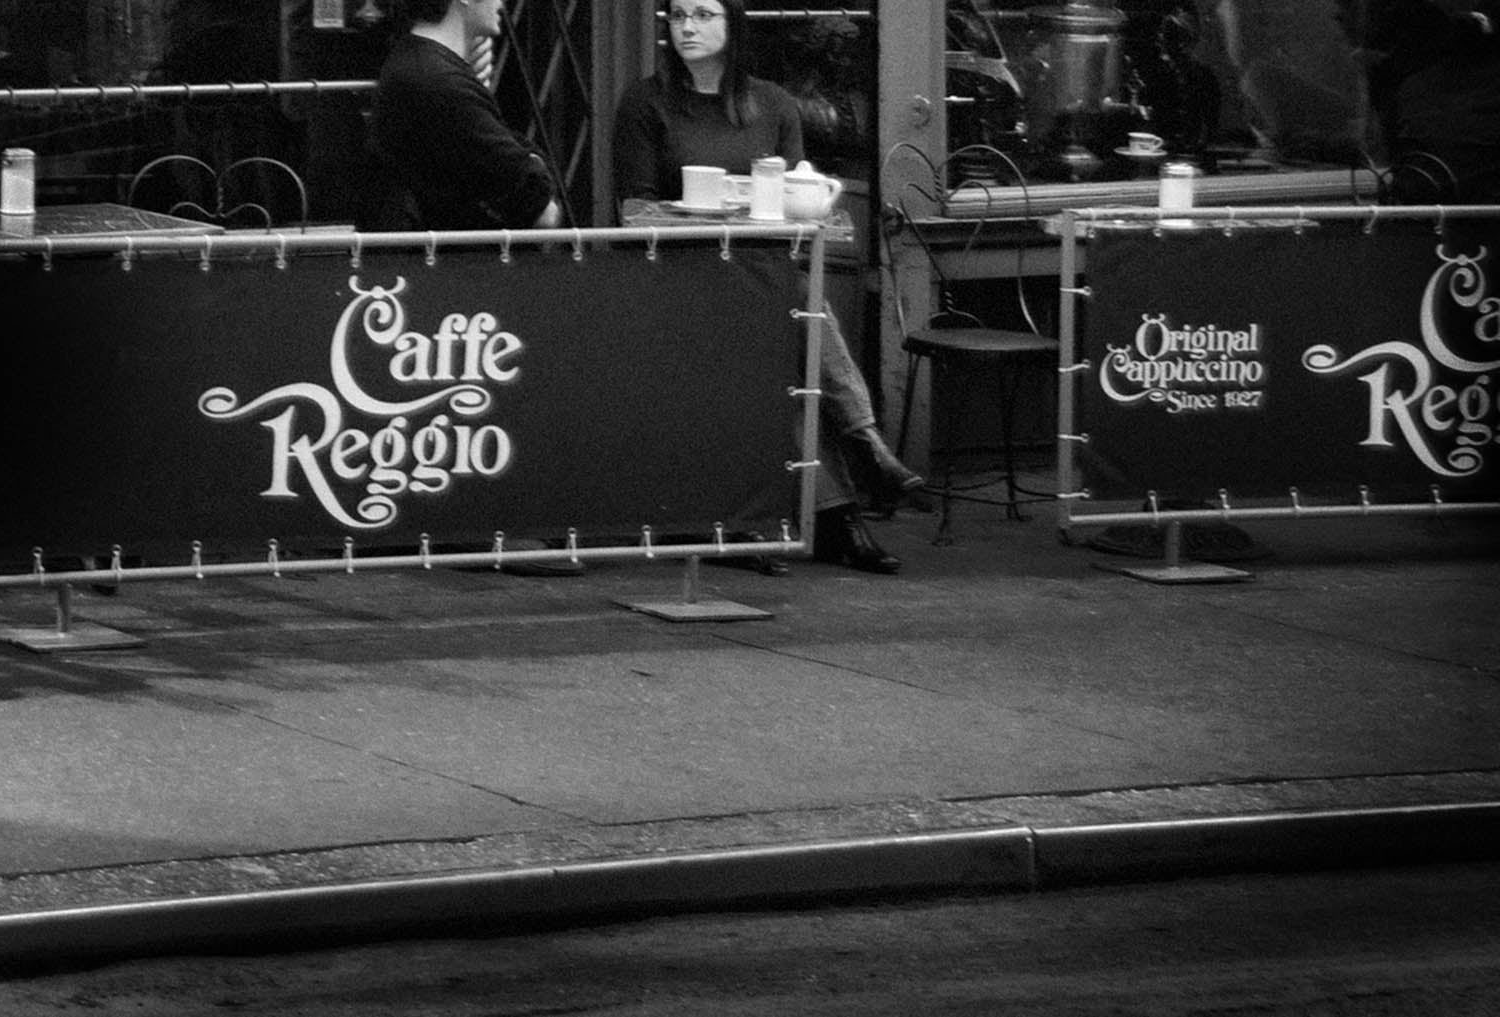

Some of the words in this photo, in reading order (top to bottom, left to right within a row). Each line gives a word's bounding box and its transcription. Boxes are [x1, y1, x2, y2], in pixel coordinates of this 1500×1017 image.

[330, 274, 525, 415] Caffe
[1135, 312, 1259, 361] Original
[1100, 343, 1264, 403] Cappuccino
[1166, 389, 1217, 415] Since
[1224, 390, 1264, 408] 1927
[197, 382, 513, 529] Reggio
